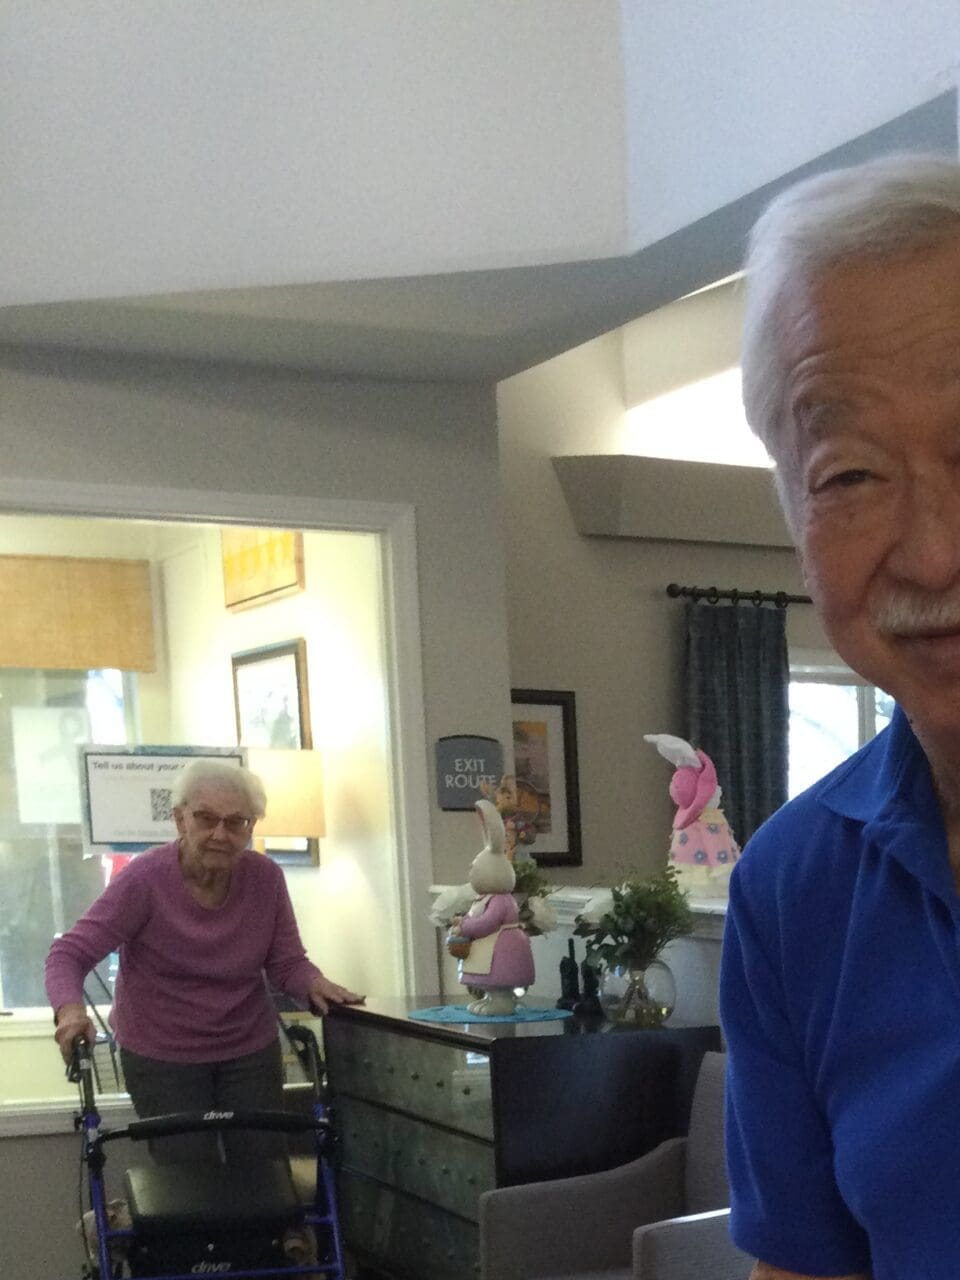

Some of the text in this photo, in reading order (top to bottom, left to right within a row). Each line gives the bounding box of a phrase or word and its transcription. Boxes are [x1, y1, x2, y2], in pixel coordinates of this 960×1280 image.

[93, 761, 109, 770] Tell
[112, 762, 123, 770] us
[126, 761, 154, 771] about
[157, 763, 178, 772] your
[454, 759, 486, 772] EXIT
[444, 774, 498, 789] ROUTE
[203, 1110, 234, 1121] drive
[191, 1260, 232, 1274] drive
